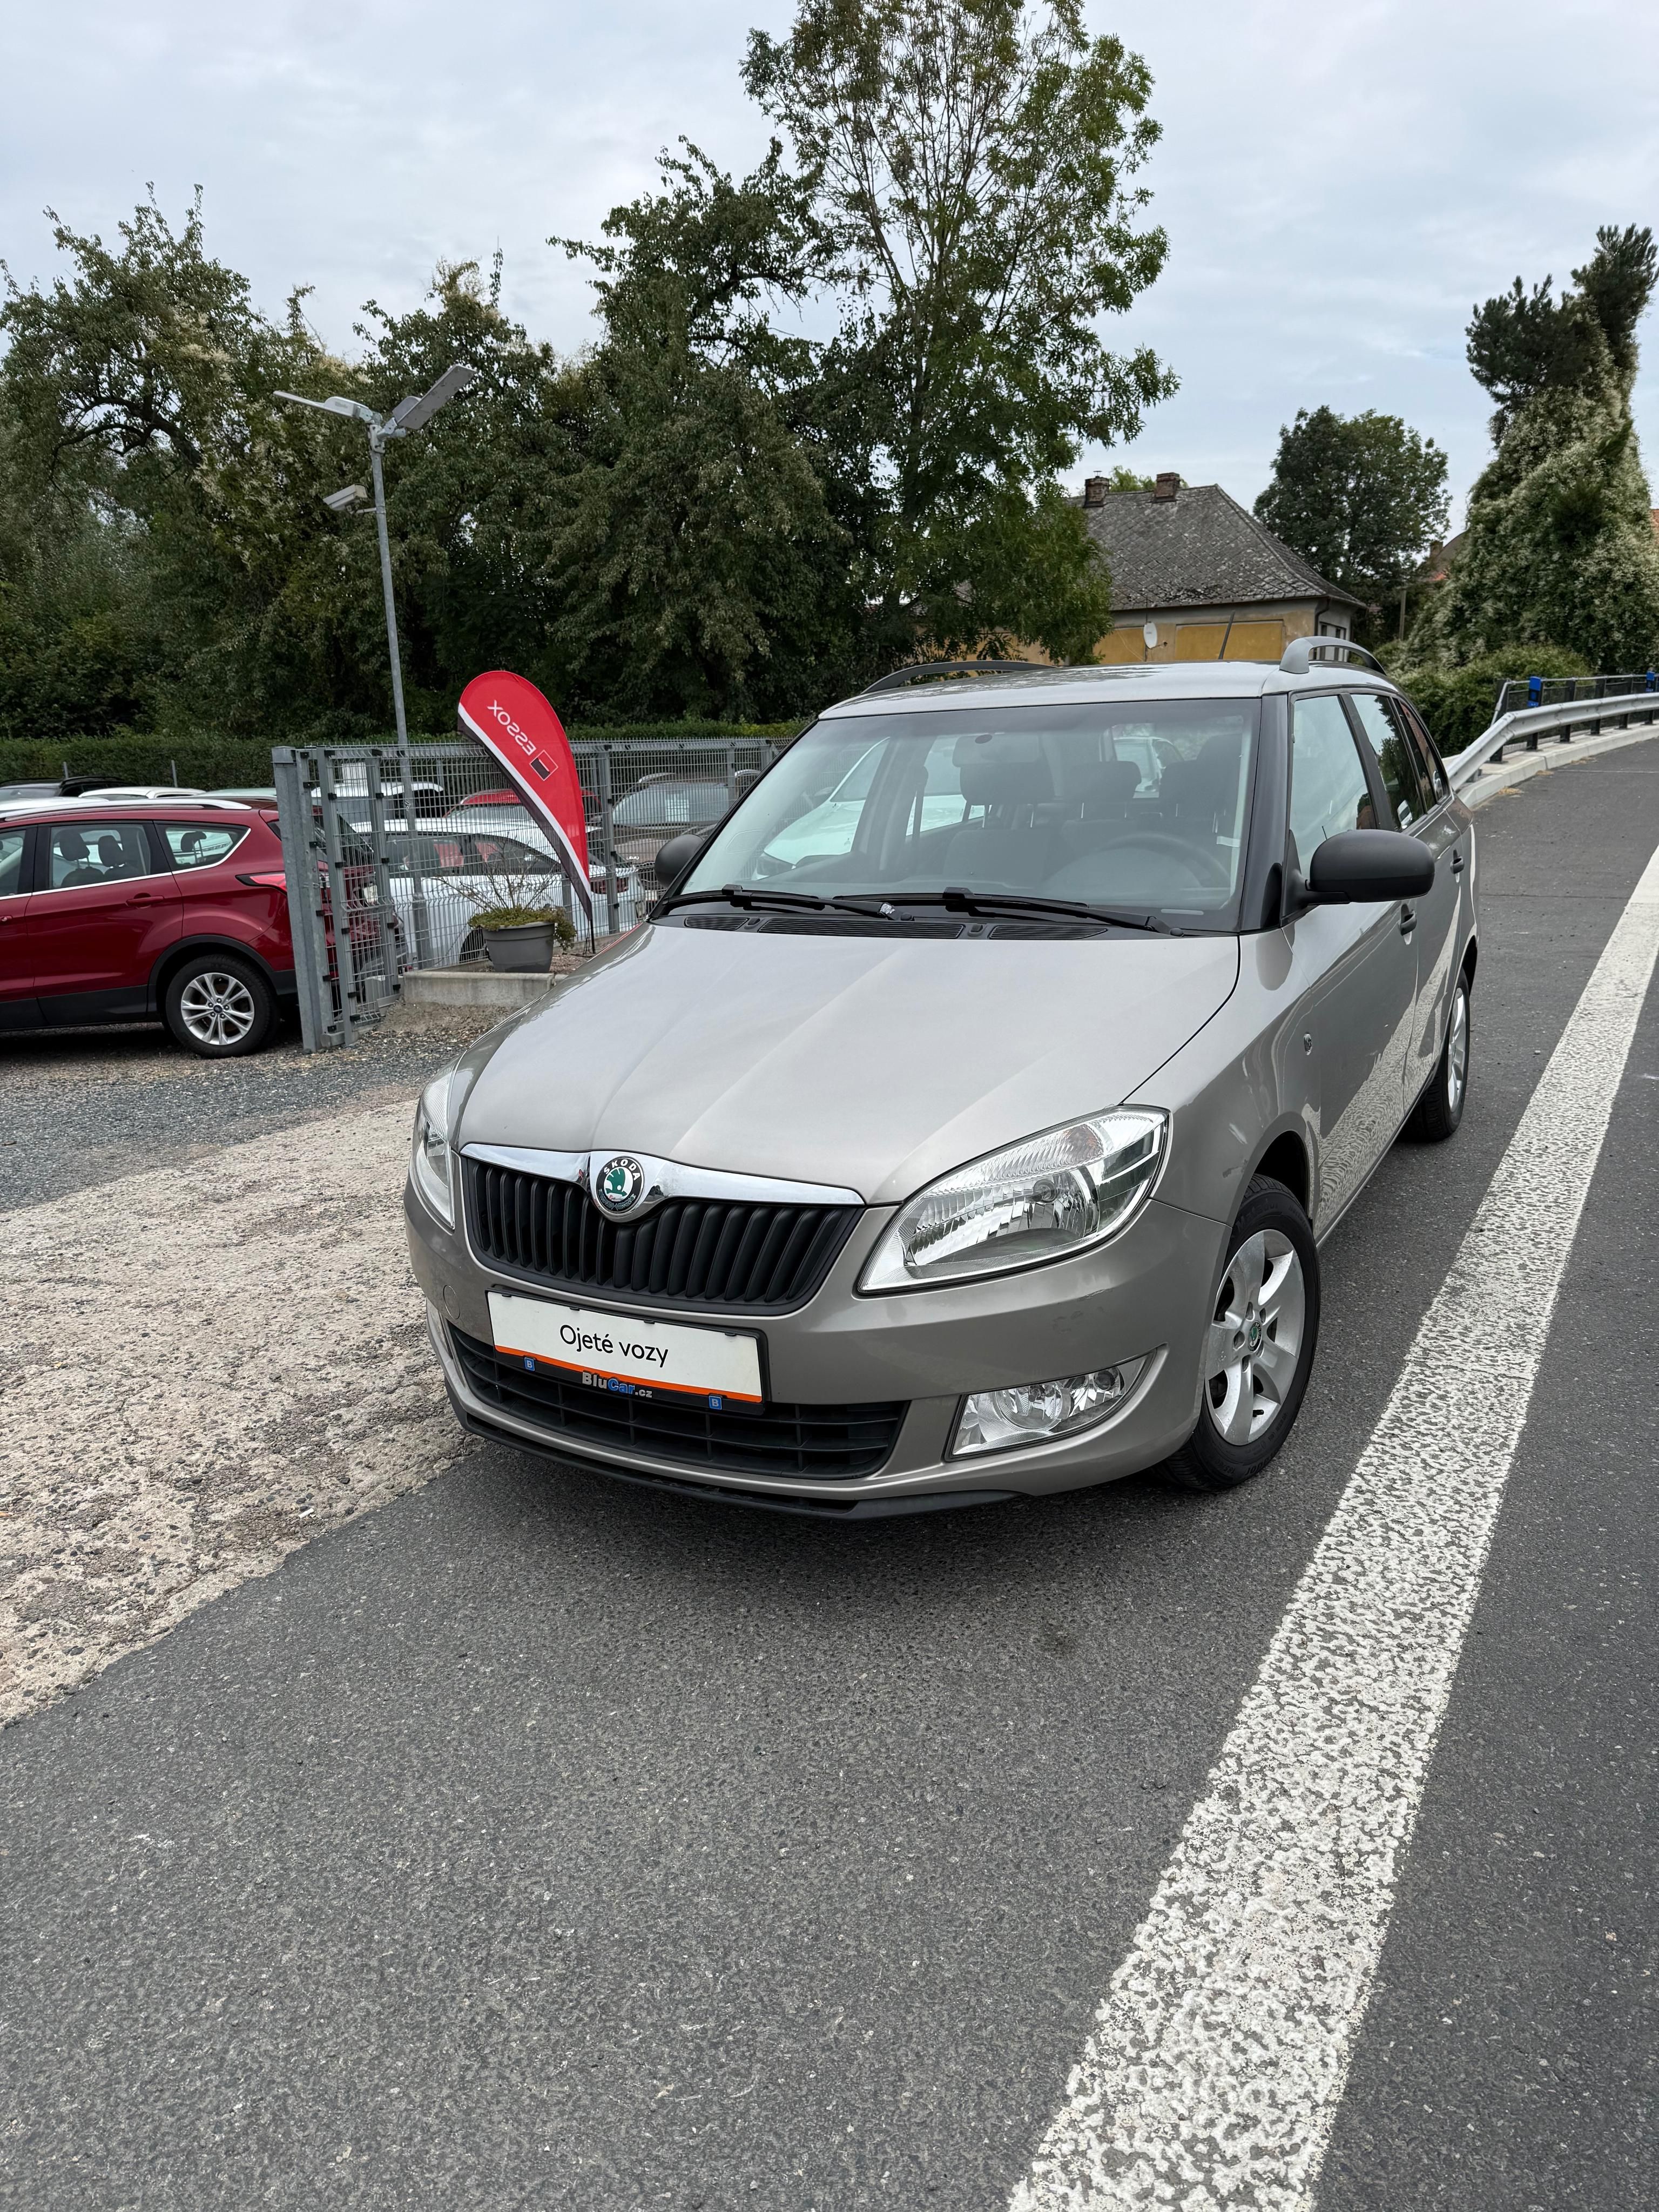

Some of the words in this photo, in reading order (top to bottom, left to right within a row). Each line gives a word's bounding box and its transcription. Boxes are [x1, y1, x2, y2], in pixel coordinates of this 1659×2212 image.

[604, 1159, 641, 1181] SKODA
[560, 1325, 613, 1353] Ojeté
[618, 1341, 669, 1368] vozy
[527, 1360, 532, 1368] B
[582, 1372, 652, 1398] BluCar.cz
